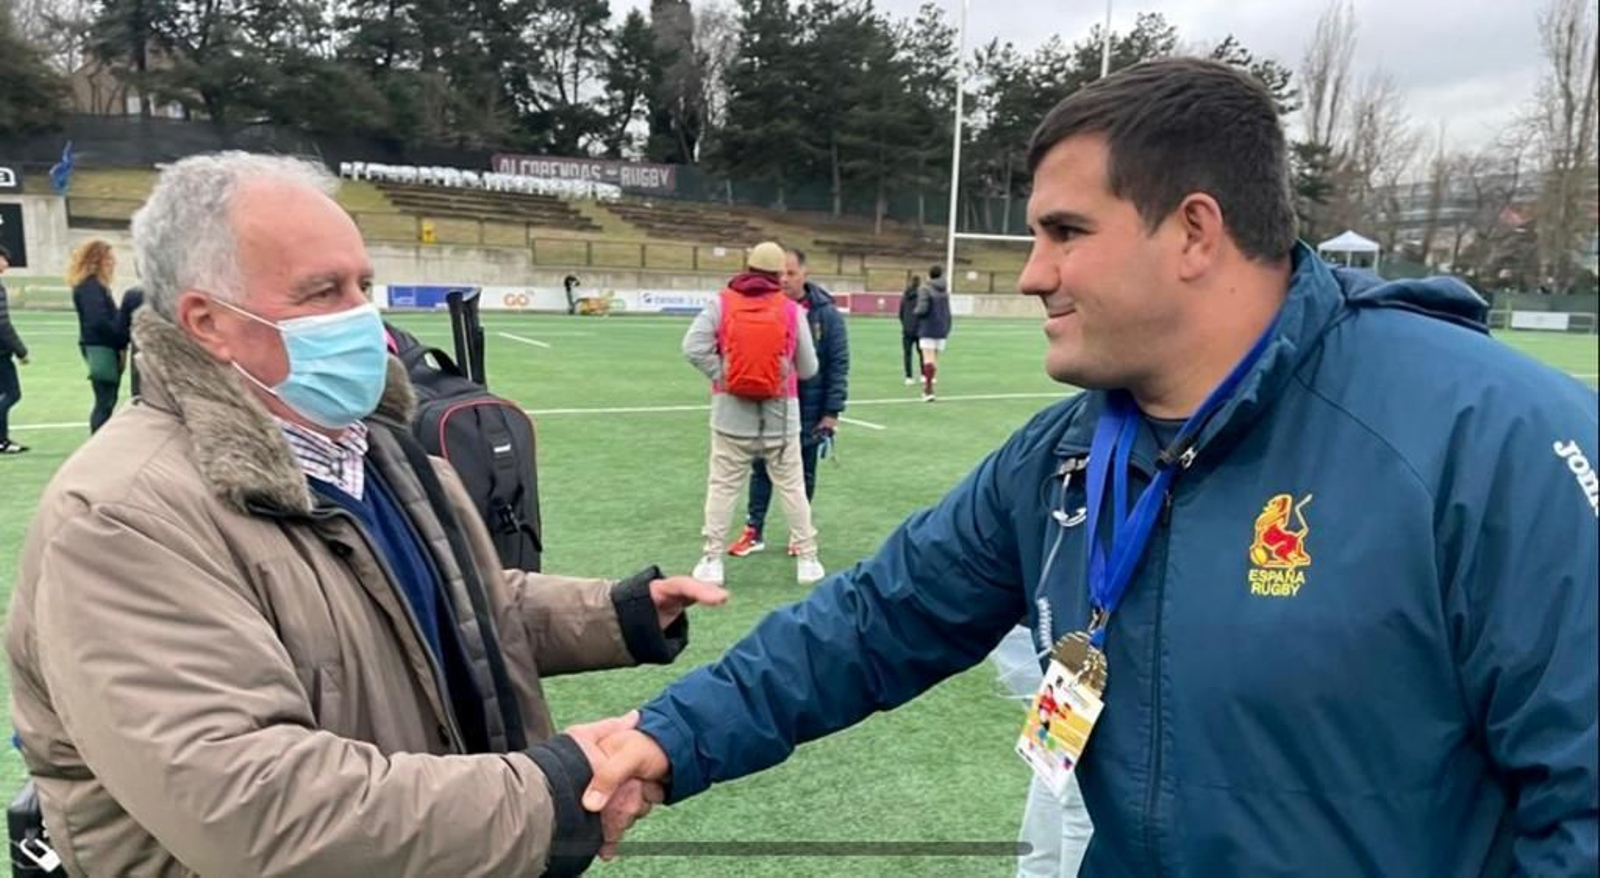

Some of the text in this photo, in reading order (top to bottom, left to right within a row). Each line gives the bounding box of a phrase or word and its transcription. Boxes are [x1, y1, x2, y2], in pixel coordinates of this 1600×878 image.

[620, 167, 670, 187] RUGBY
[1553, 439, 1598, 518] Jom
[1249, 569, 1305, 583] ESPAÑA
[1251, 582, 1300, 596] RUGBY
